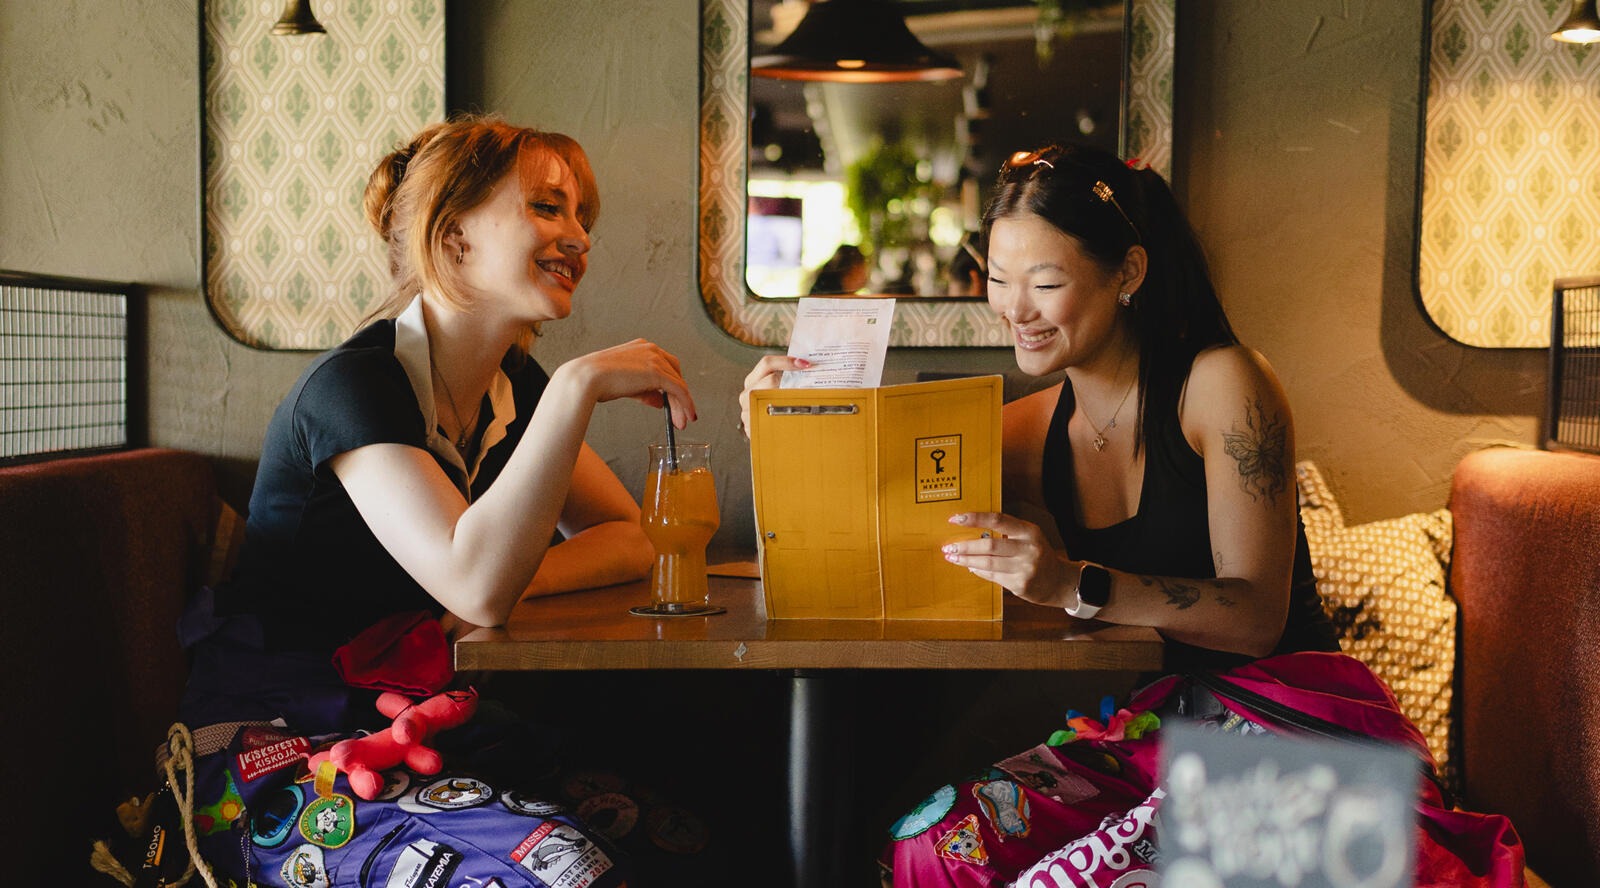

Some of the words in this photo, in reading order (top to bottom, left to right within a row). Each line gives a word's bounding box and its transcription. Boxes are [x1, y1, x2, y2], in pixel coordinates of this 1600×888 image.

[255, 748, 298, 769] KISKOJA
[143, 825, 161, 869] TAGOMO
[514, 821, 556, 858] MISSIN
[556, 870, 575, 887] LAST
[574, 855, 591, 870] SEEN
[567, 859, 600, 888] HERVANTA
